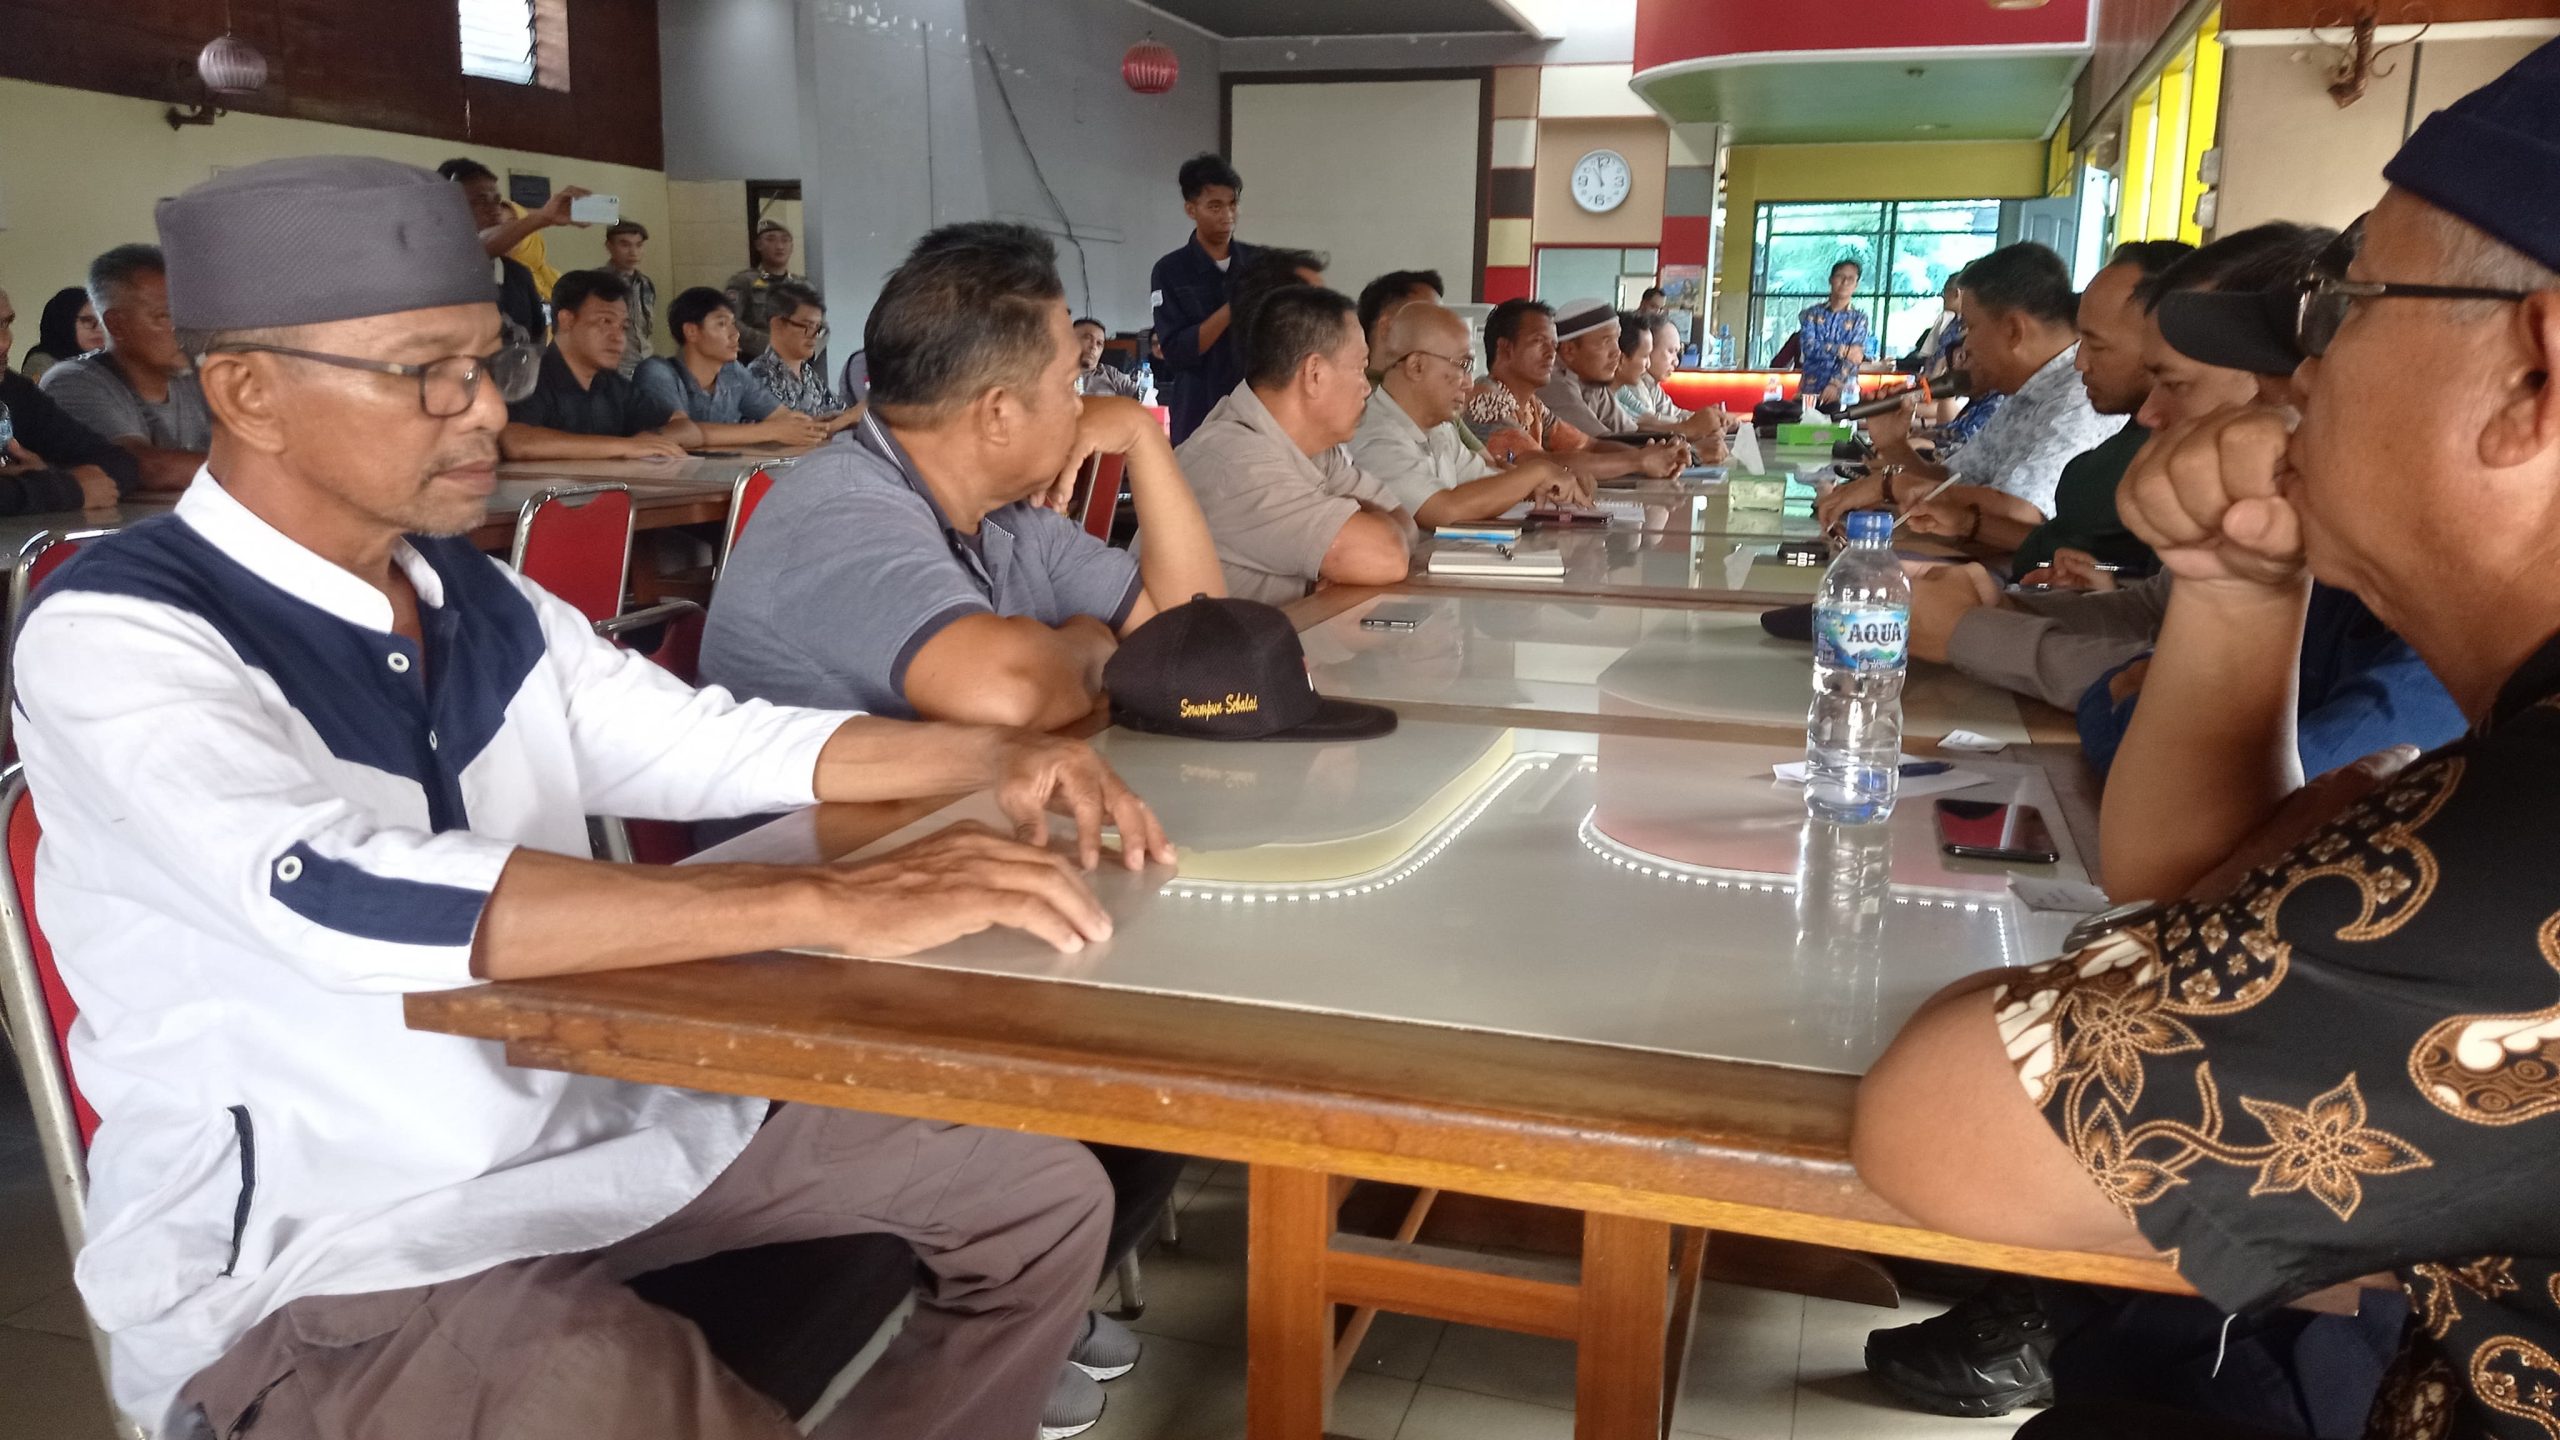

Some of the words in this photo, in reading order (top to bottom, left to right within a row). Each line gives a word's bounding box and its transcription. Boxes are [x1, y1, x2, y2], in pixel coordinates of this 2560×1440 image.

[1578, 174, 1589, 188] 9
[1614, 175, 1625, 188] 3
[1594, 194, 1605, 207] 6
[1847, 622, 1902, 646] AQUA
